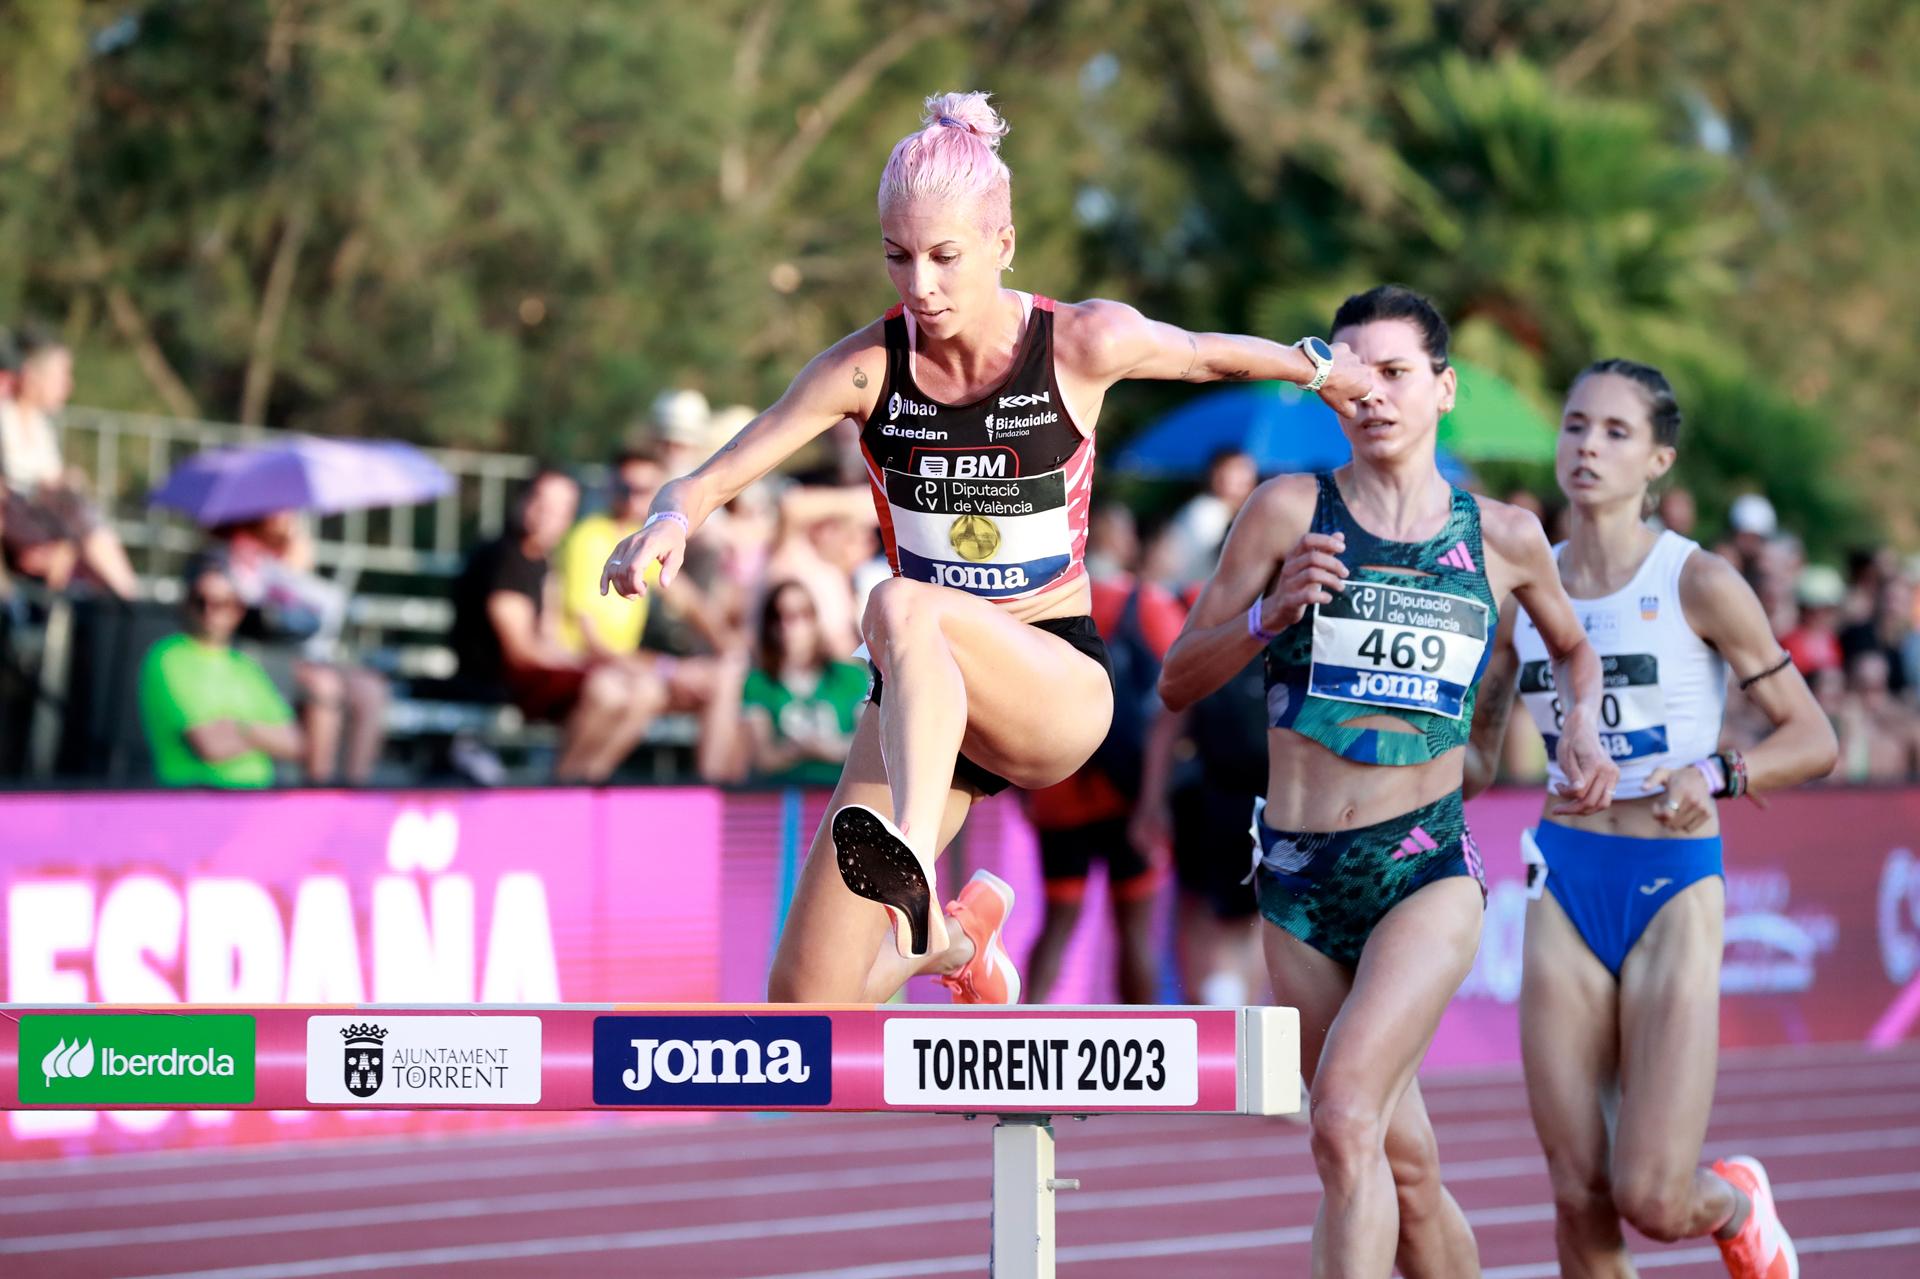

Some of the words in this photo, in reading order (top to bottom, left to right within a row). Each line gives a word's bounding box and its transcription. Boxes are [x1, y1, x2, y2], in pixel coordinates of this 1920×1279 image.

[995, 411, 1058, 431] Bizkaialde
[883, 425, 948, 440] Guedan
[995, 428, 1030, 439] fundazioa
[954, 453, 1006, 478] BM
[952, 482, 1020, 500] Diputació
[953, 501, 972, 512] de
[974, 501, 1033, 514] València
[1389, 592, 1452, 613] Diputació
[1387, 611, 1405, 623] de
[1408, 612, 1460, 632] València
[1357, 628, 1446, 673] 469
[101, 1047, 235, 1077] Iberdrola
[392, 1048, 509, 1066] AJUNTAMENT
[912, 1038, 1069, 1091] TORRENT
[1076, 1038, 1166, 1091] 2023
[392, 1066, 509, 1089] TORRENT
